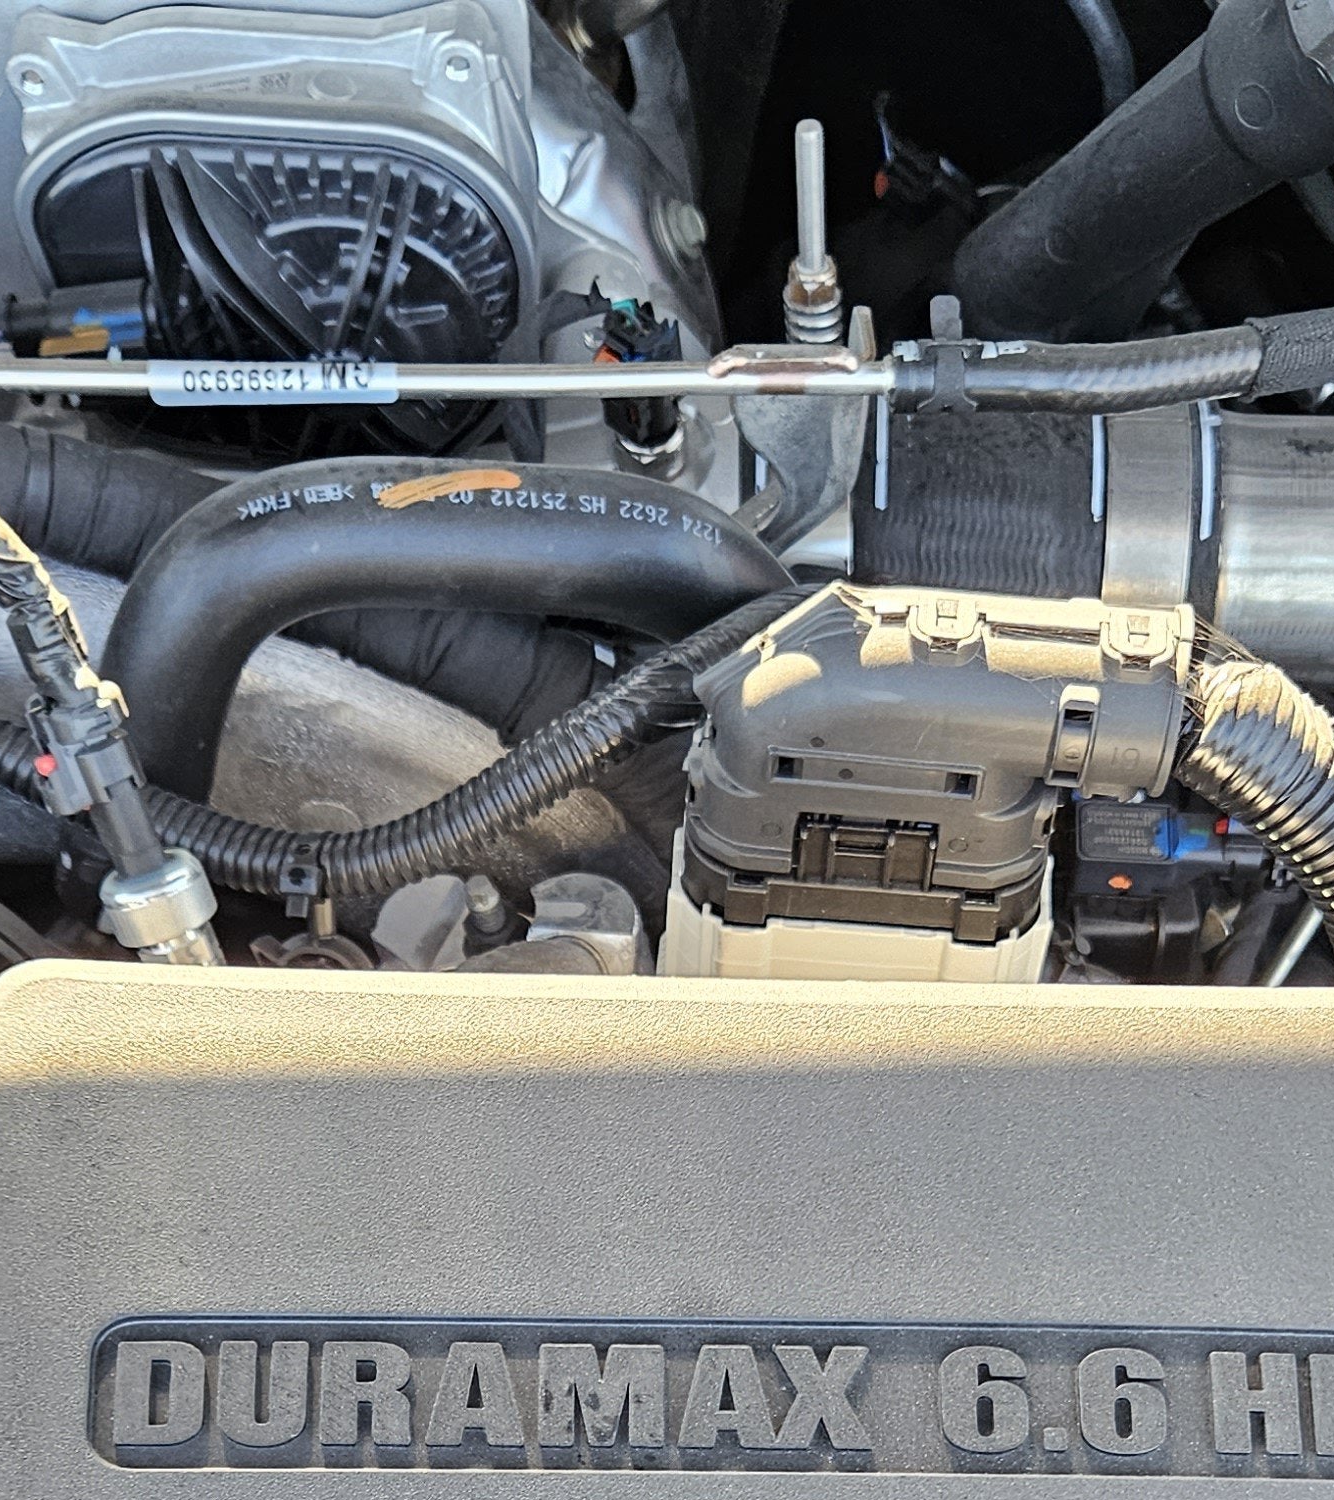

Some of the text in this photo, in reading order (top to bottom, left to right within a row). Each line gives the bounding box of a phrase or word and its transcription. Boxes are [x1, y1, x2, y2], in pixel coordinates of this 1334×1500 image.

[183, 360, 372, 393] GM 12695930
[490, 489, 568, 511] 251212
[579, 494, 607, 515] HS
[619, 499, 670, 526] 2622
[681, 513, 723, 547] 1274
[113, 1340, 873, 1451] DURAMAX
[938, 1345, 1168, 1457] 6.6
